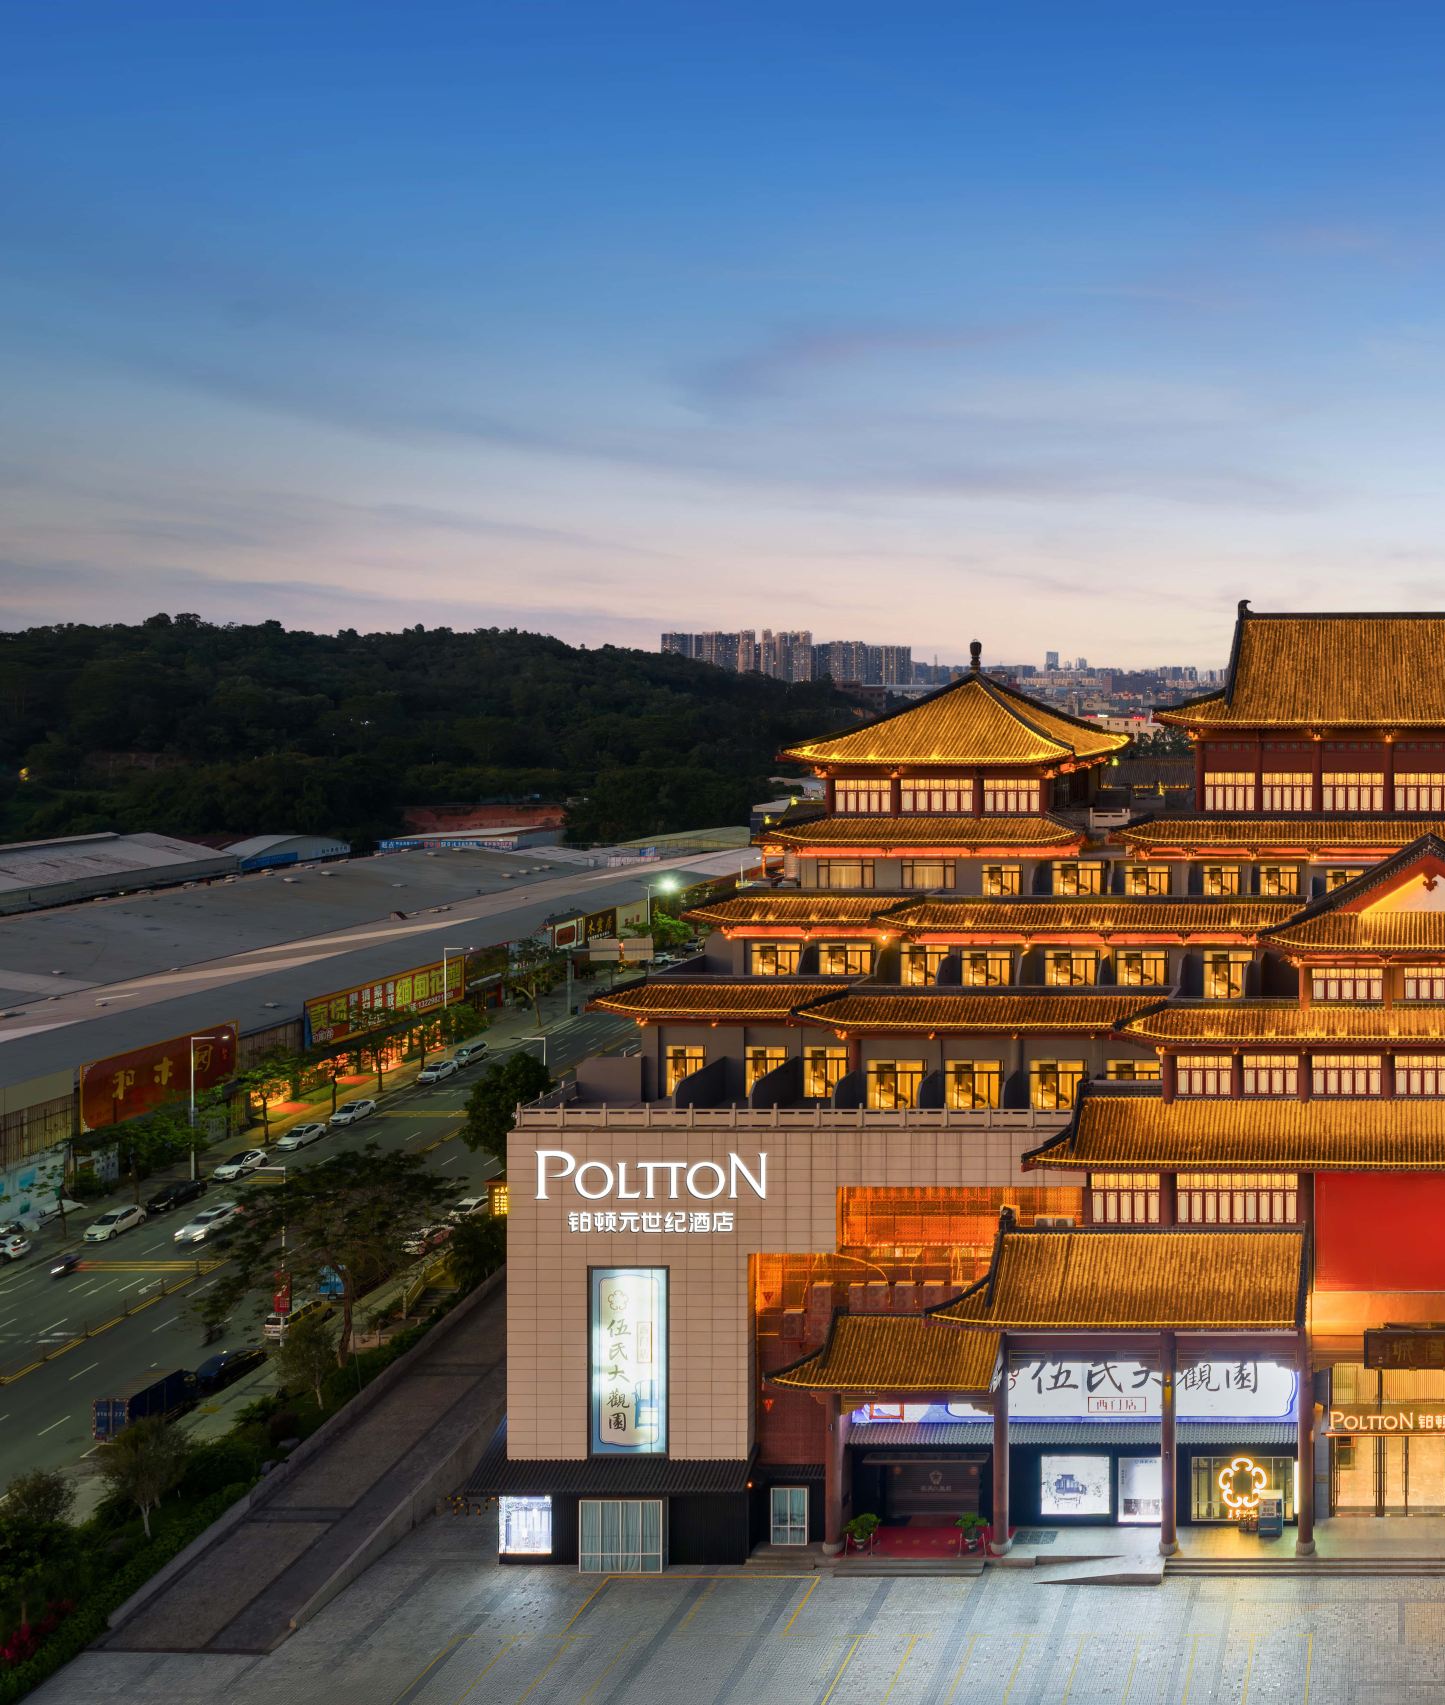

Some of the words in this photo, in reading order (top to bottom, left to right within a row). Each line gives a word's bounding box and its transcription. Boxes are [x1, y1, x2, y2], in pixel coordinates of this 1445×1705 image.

[568, 1211, 734, 1233] 铂顿元世纪酒店
[607, 1319, 631, 1431] 伍氏大觀園
